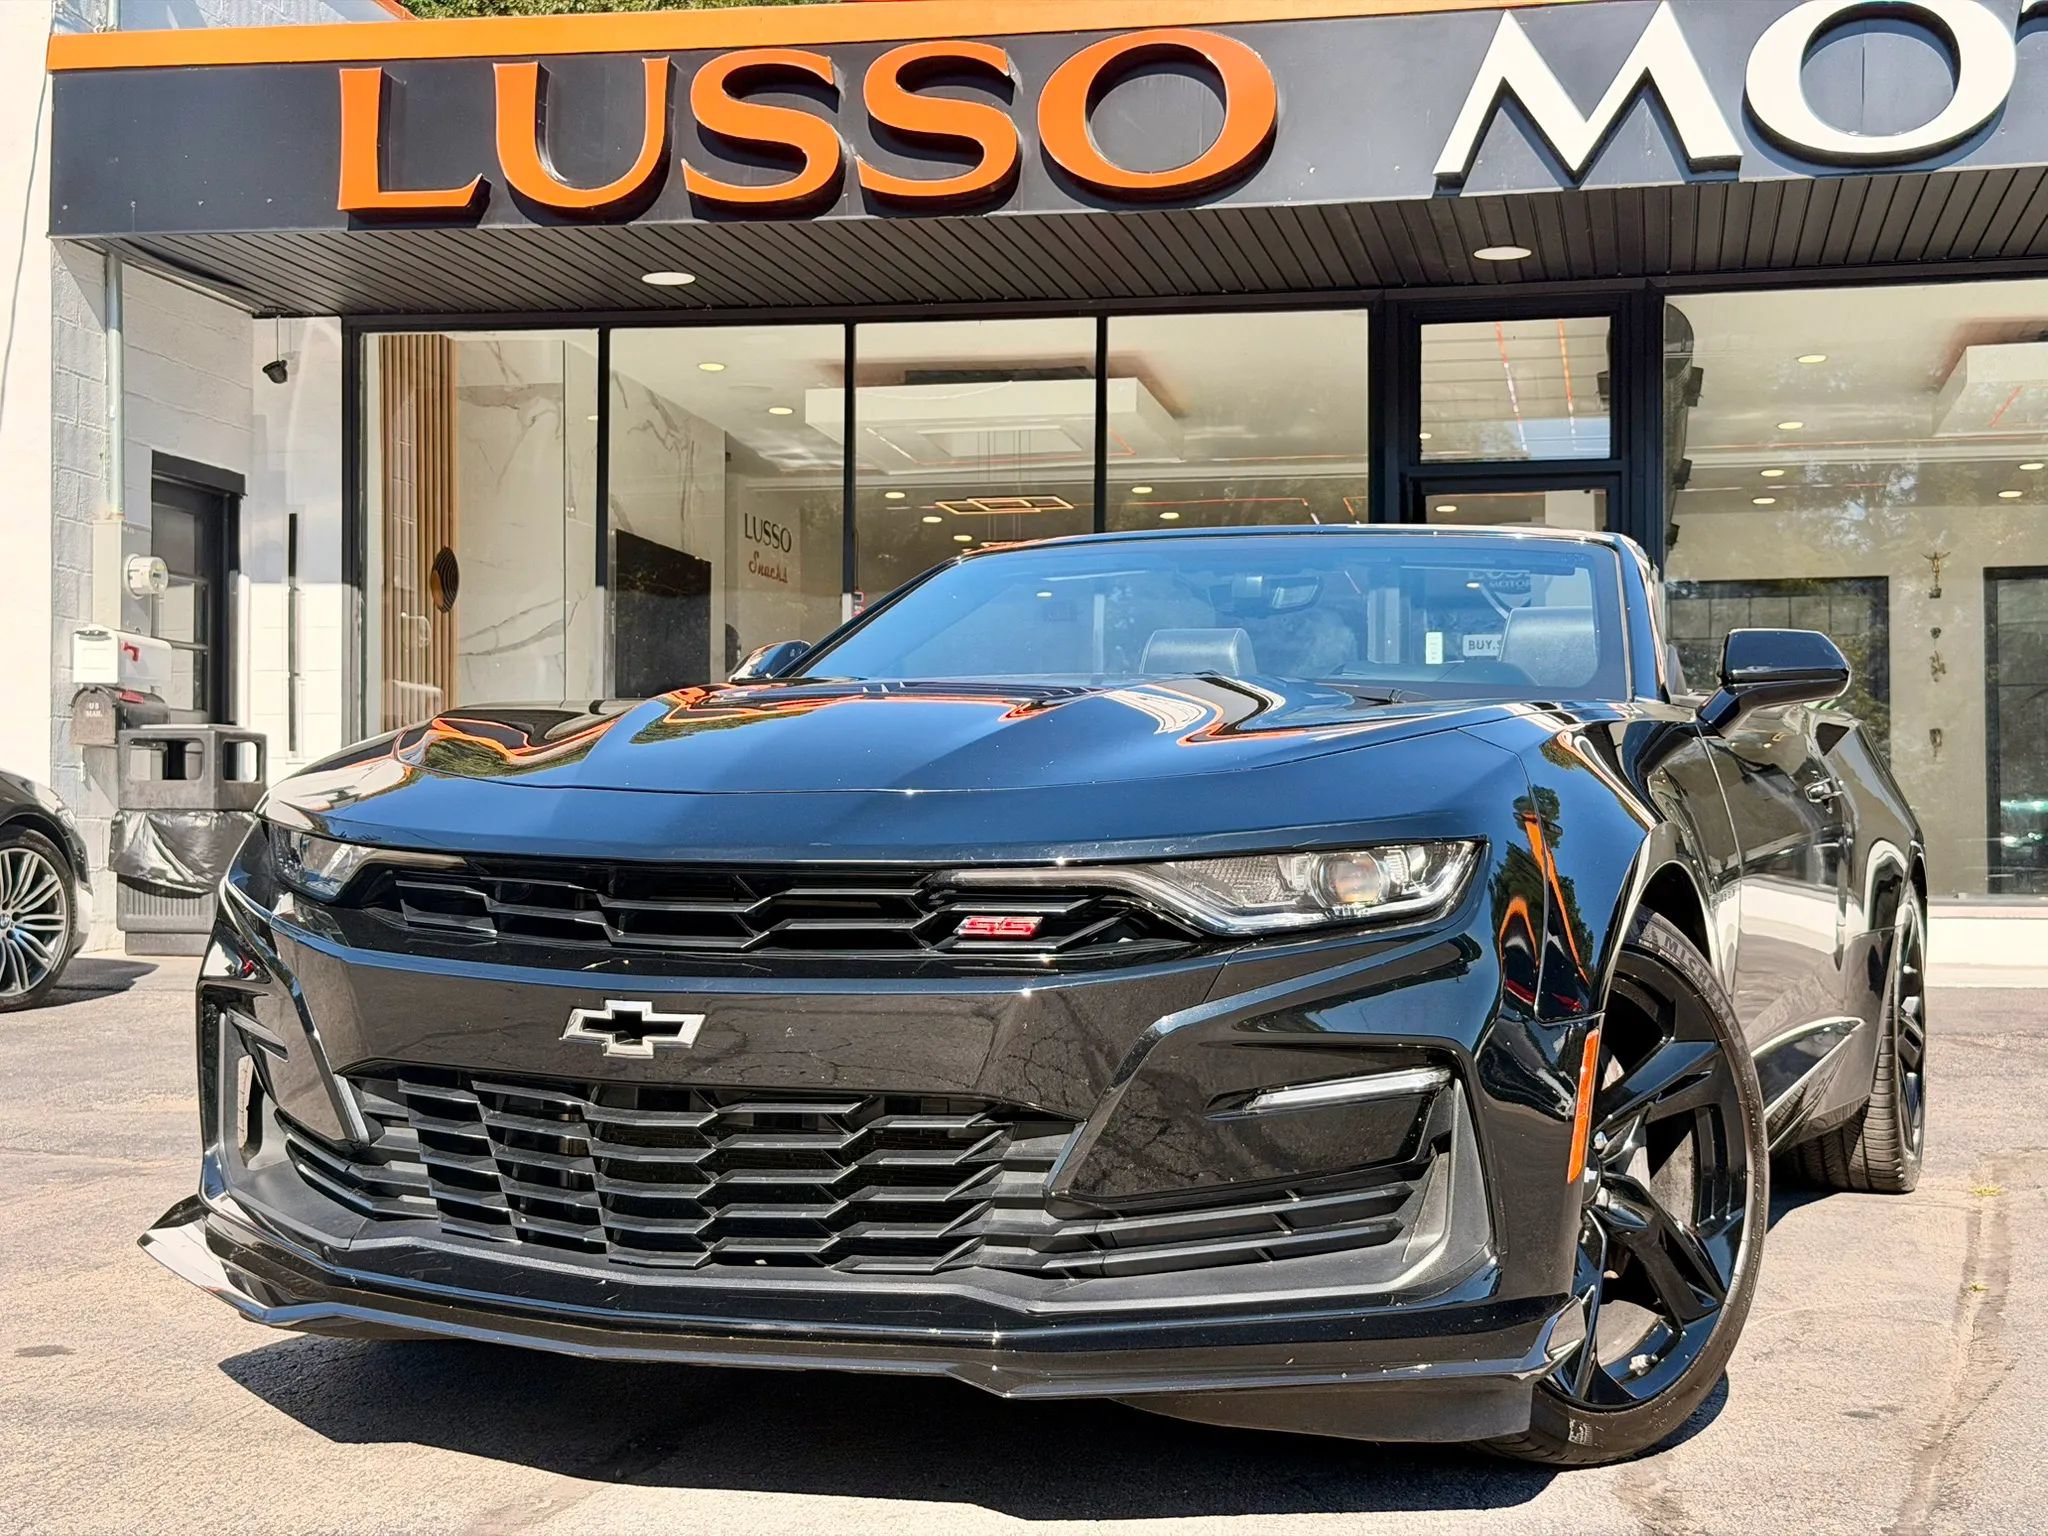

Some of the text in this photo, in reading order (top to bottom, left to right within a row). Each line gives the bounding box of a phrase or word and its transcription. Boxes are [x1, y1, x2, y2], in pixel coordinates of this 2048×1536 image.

[338, 0, 2048, 211] LUSSO MO
[744, 512, 792, 553] LUSSO
[954, 916, 1043, 937] SS
